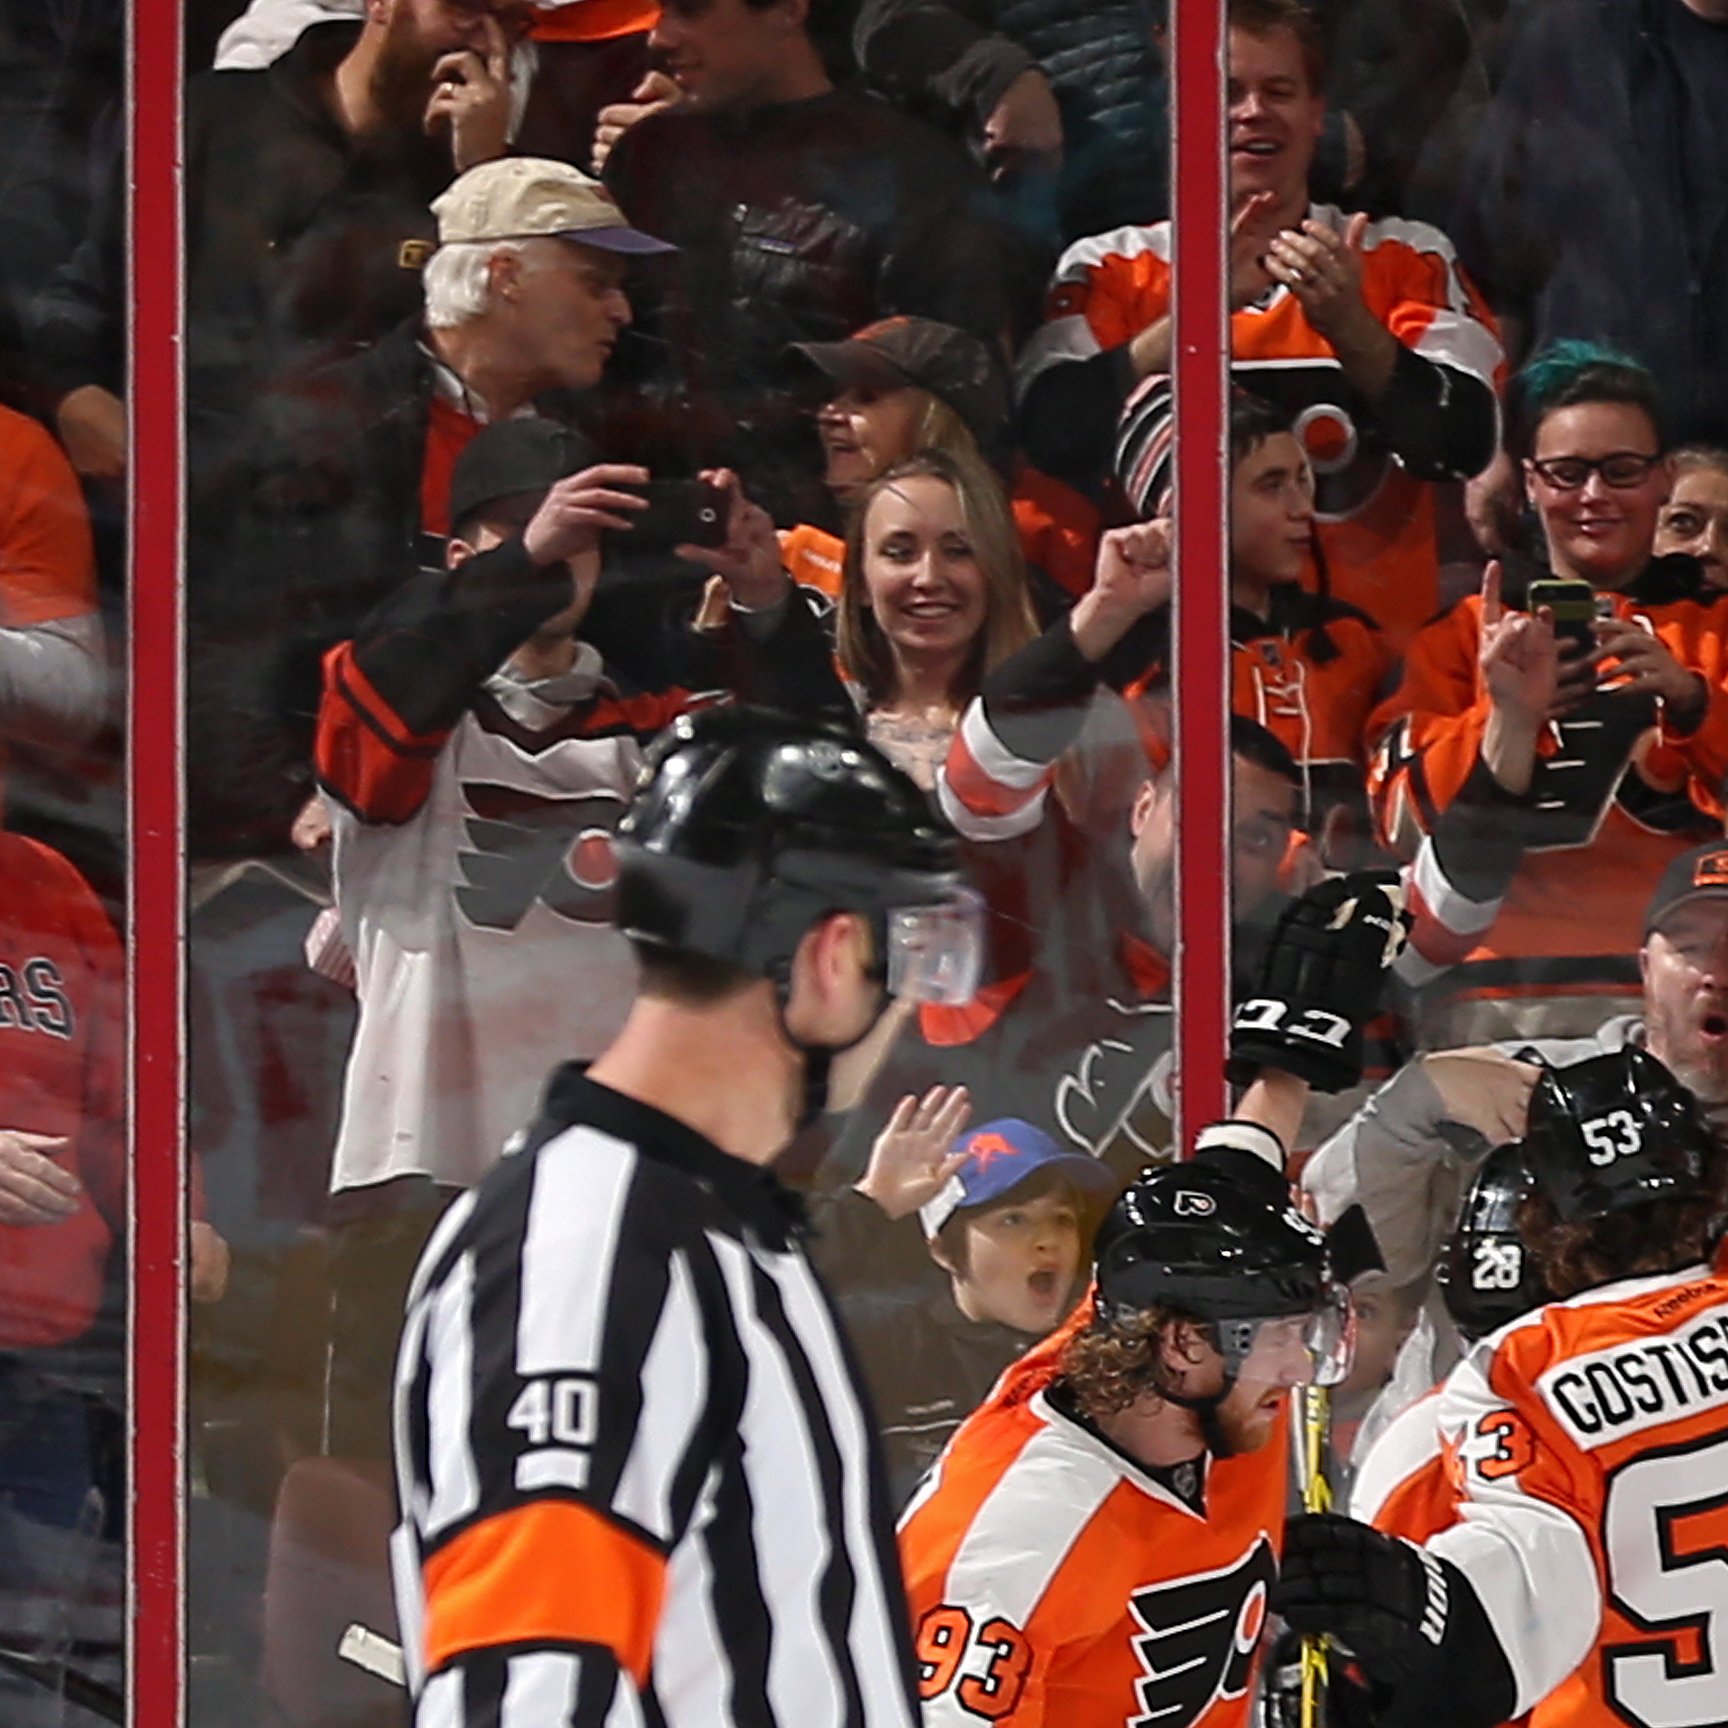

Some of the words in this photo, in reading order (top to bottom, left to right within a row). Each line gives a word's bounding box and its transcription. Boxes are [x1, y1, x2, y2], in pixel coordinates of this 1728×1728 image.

[1581, 1109, 1643, 1166] 53
[1472, 1239, 1523, 1290] 28
[506, 1379, 600, 1445] 40
[918, 1605, 1035, 1720] 93
